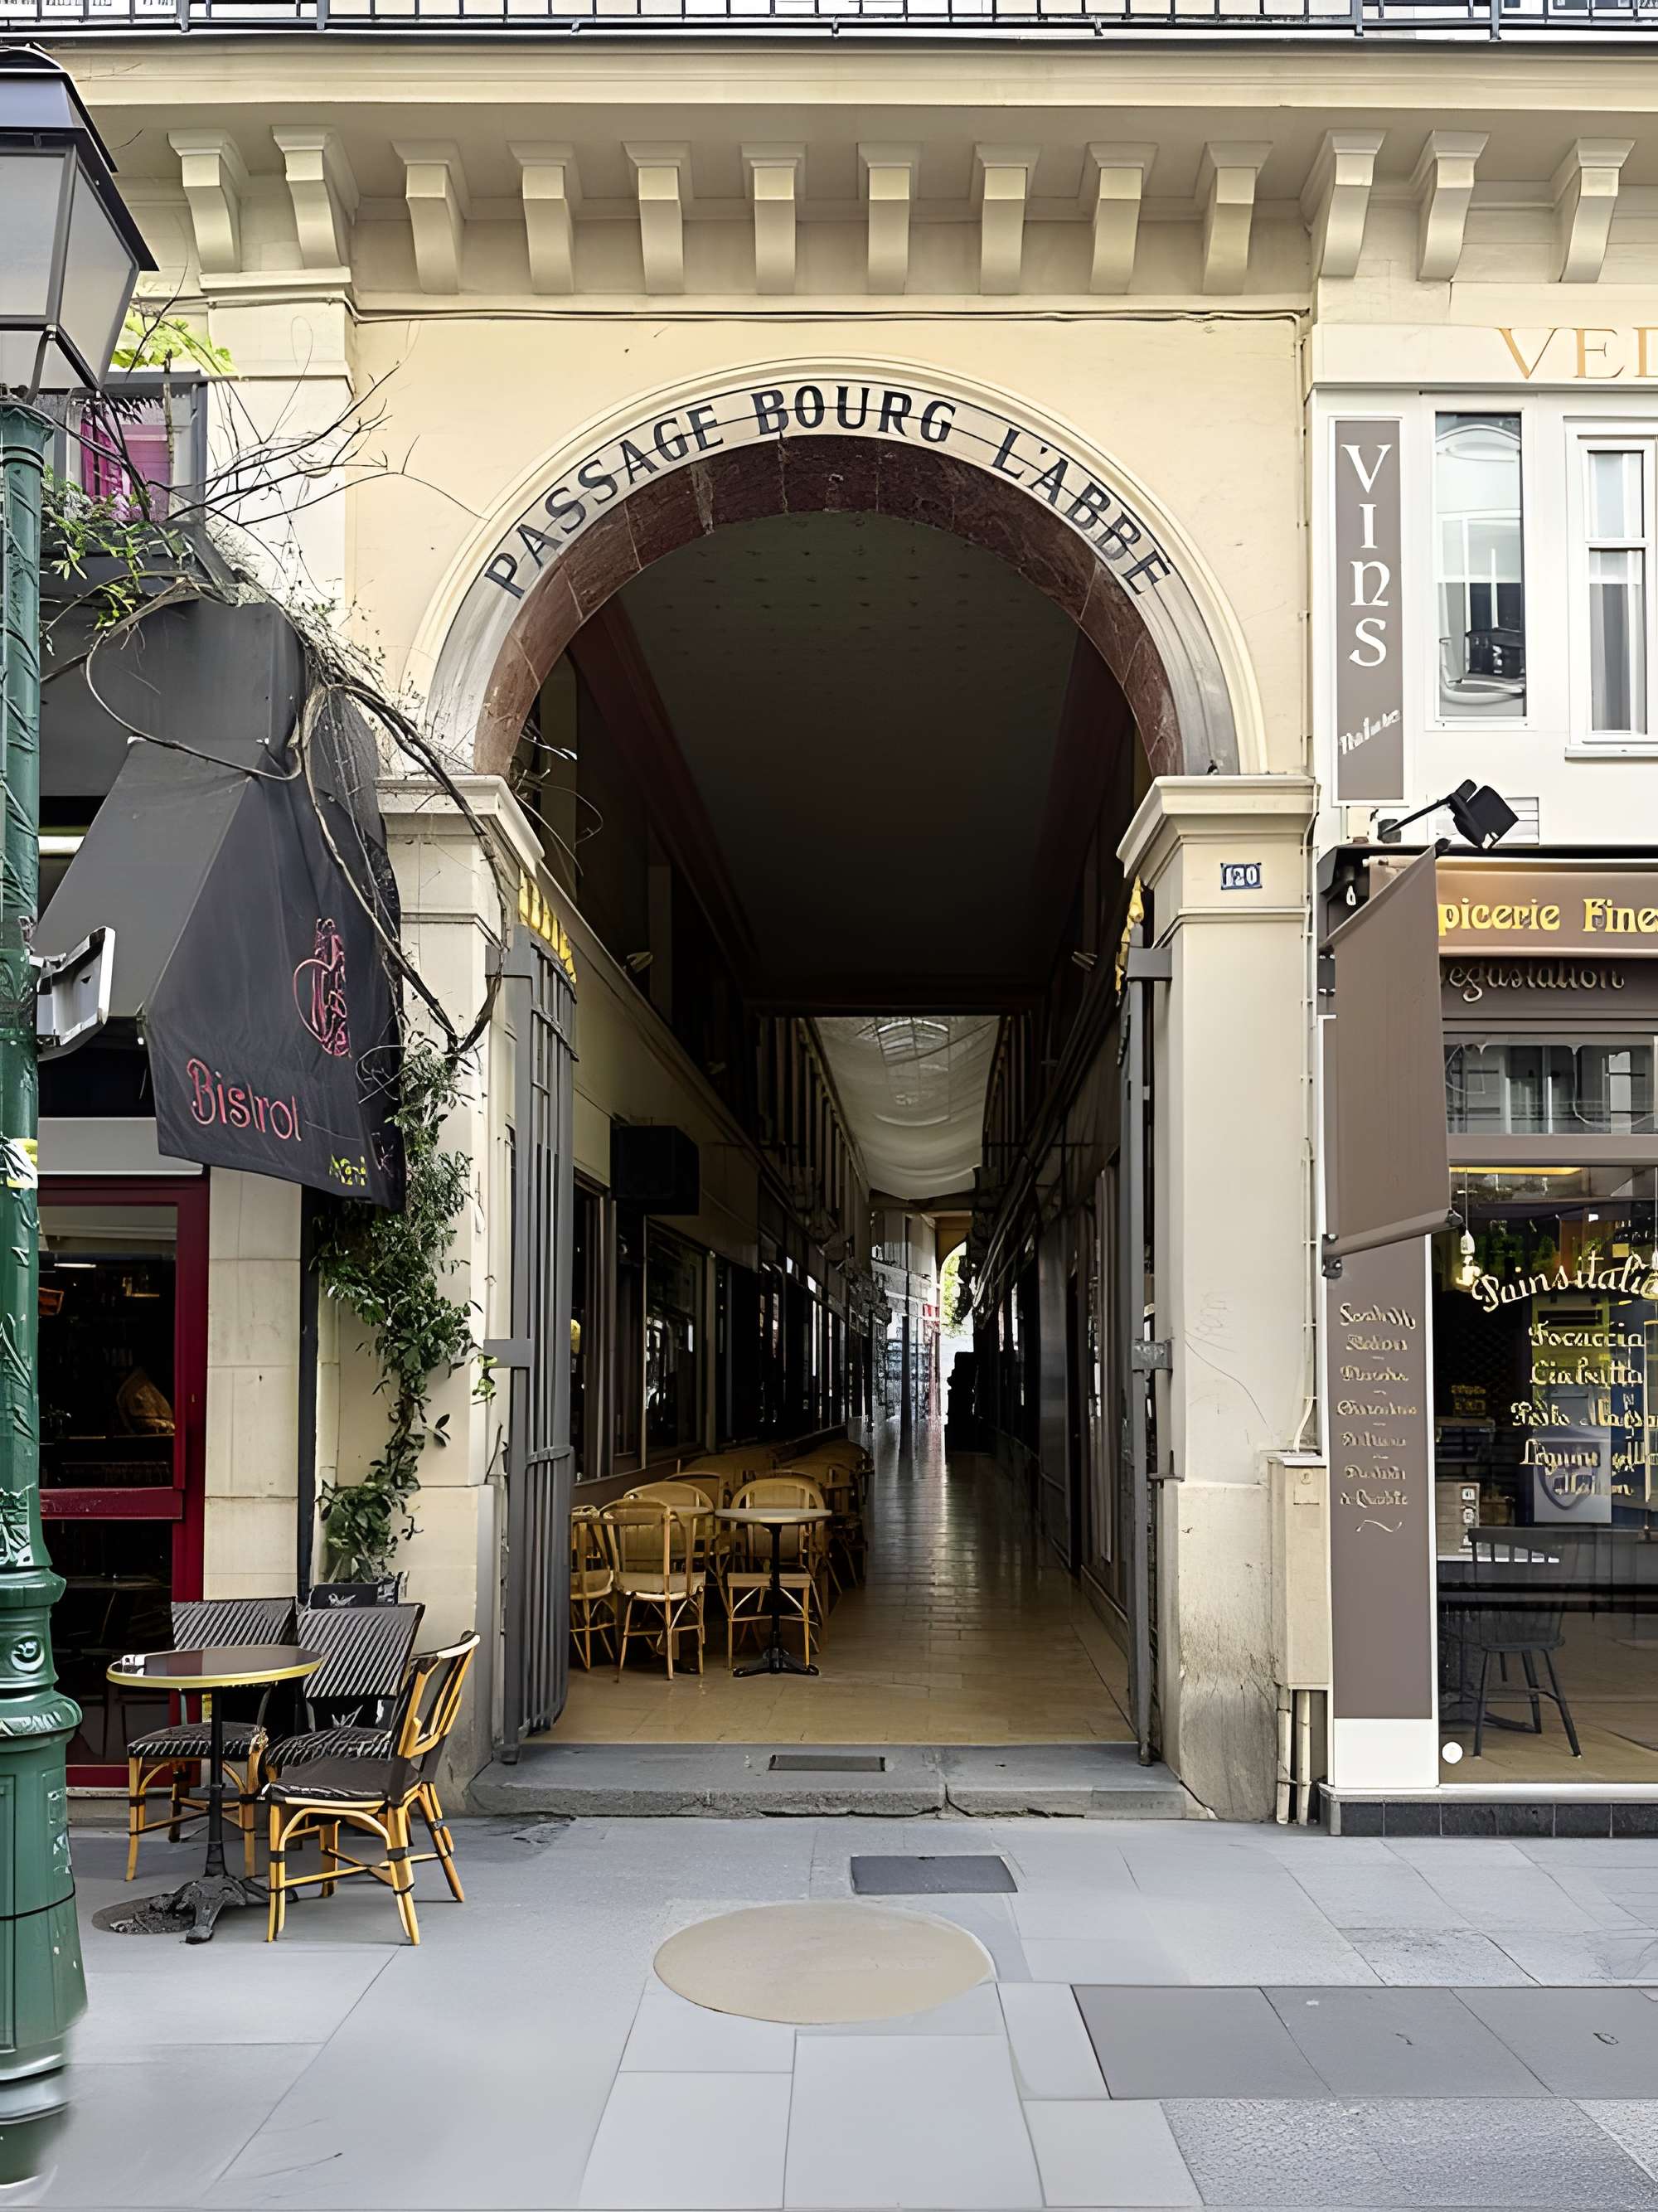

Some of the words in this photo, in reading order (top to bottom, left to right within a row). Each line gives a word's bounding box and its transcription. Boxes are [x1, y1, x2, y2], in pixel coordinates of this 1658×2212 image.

[483, 404, 726, 599] PASSAGE
[750, 384, 957, 444] BOURG
[1438, 897, 1560, 936] picerie
